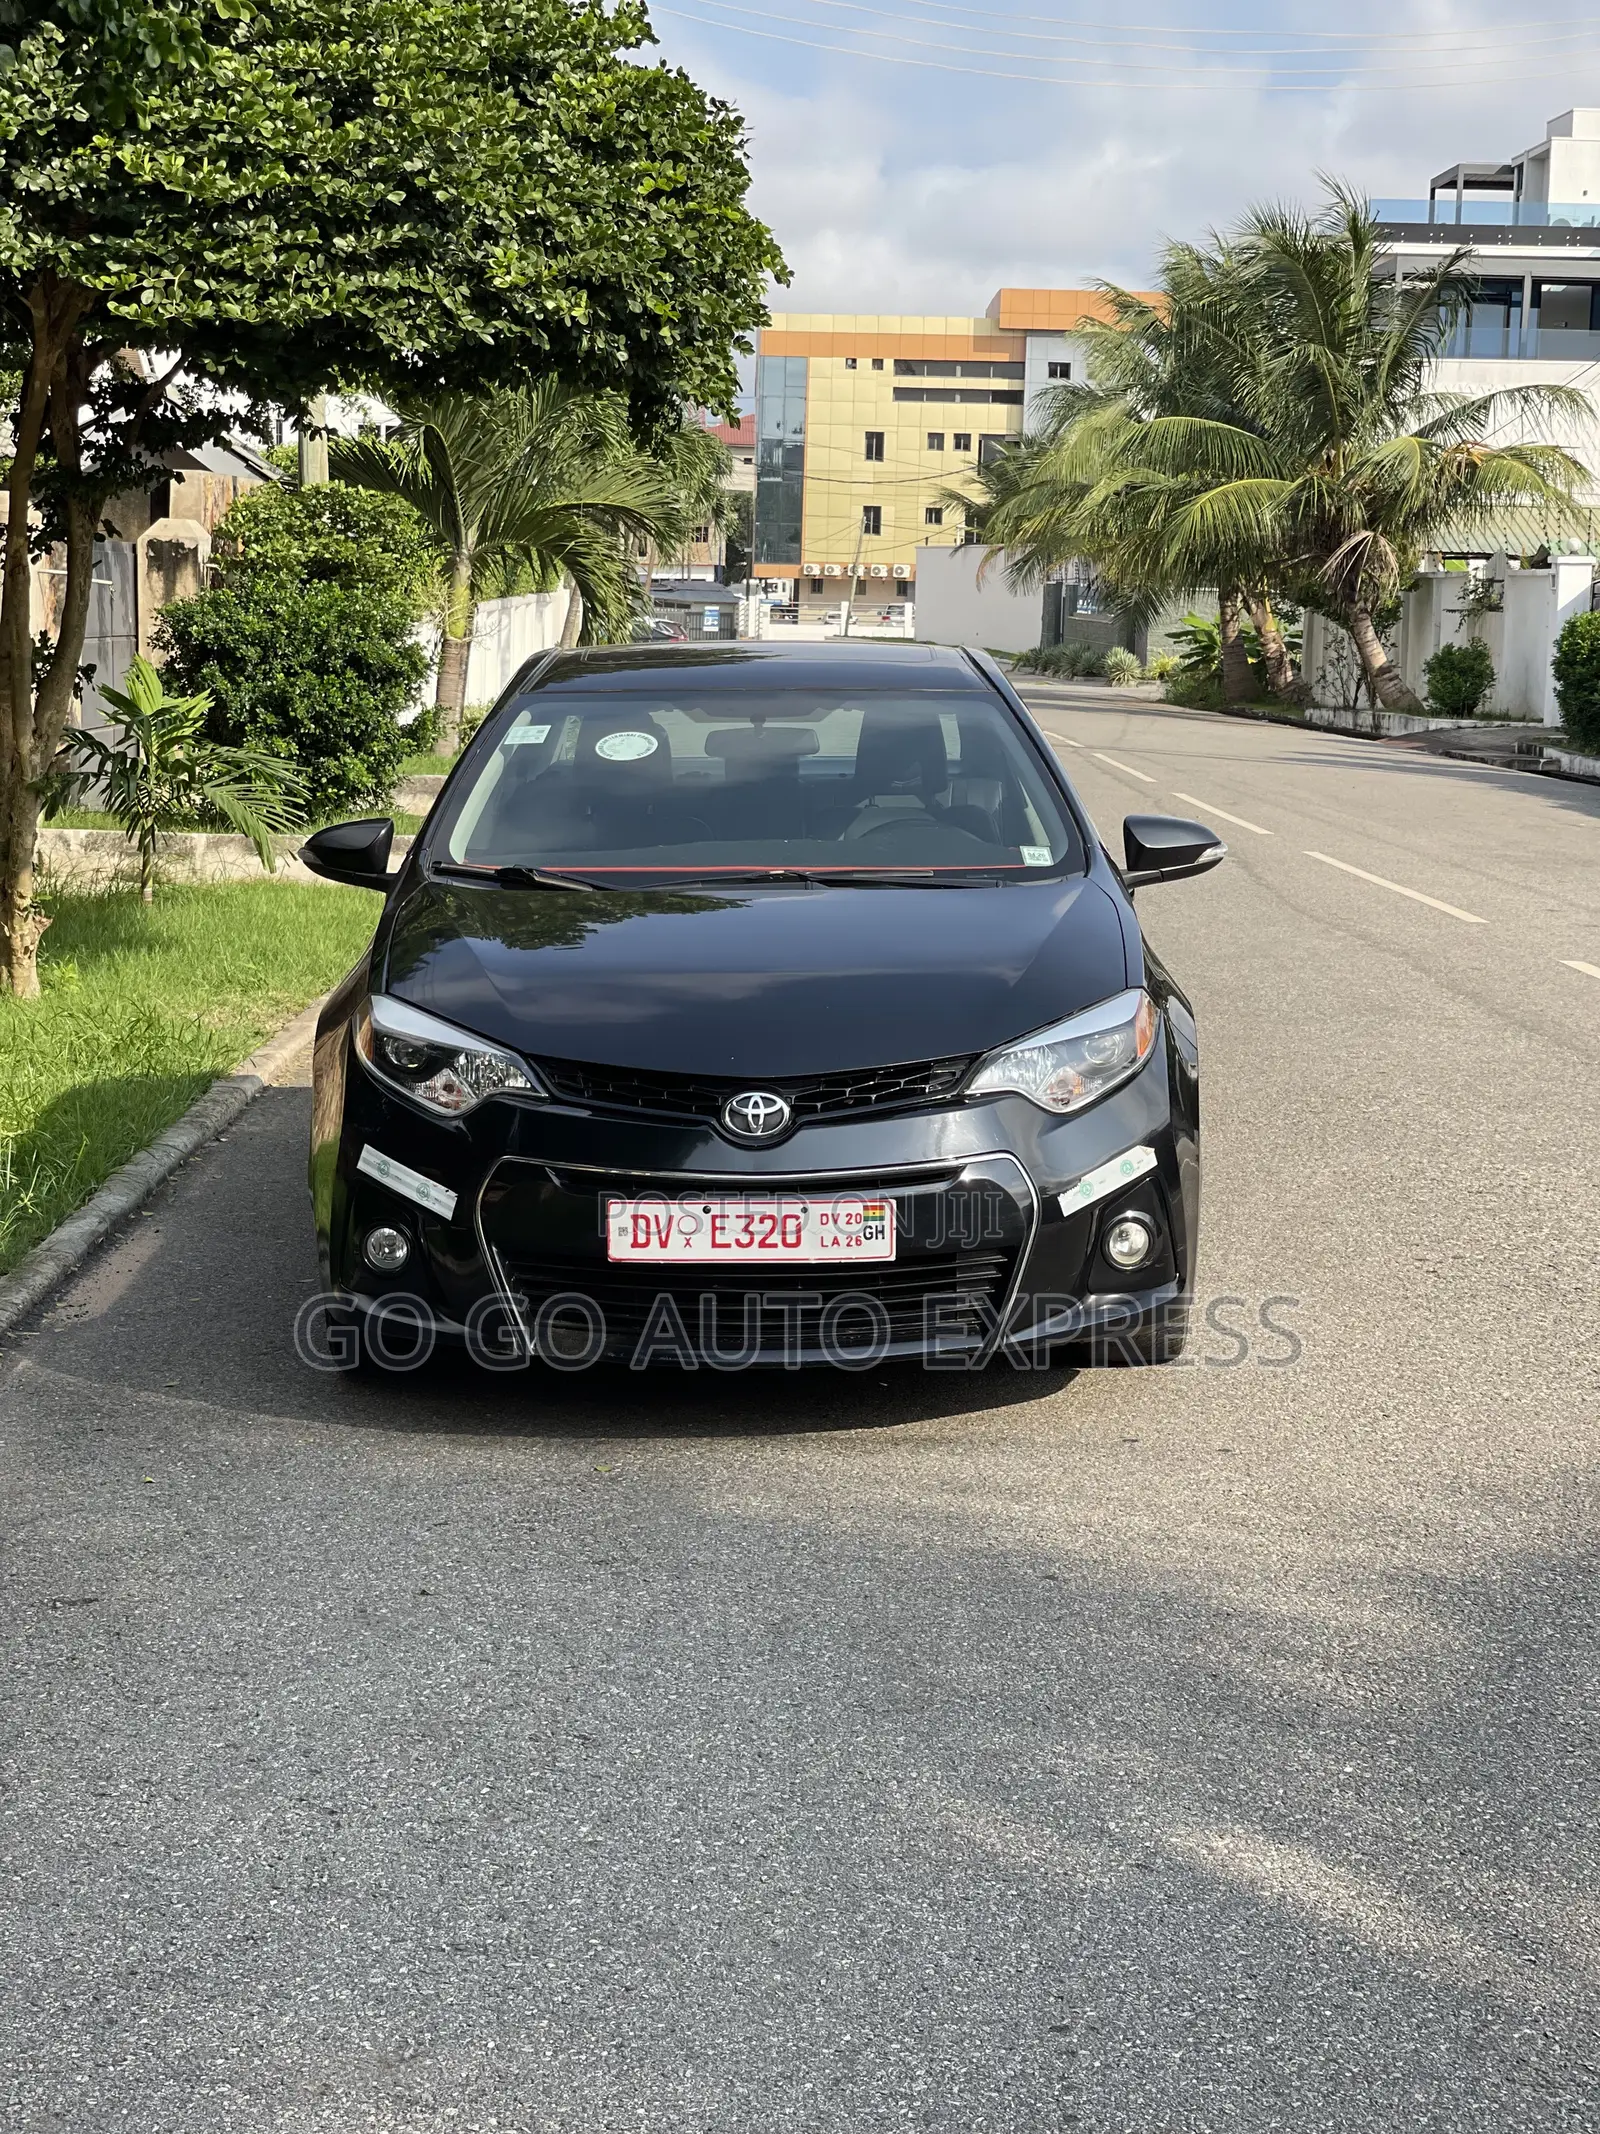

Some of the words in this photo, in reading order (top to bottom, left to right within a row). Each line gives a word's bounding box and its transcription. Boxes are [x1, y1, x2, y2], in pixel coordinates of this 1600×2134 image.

[820, 1213, 840, 1225] DV
[845, 1212, 862, 1225] 20
[630, 1214, 674, 1249] DV
[711, 1213, 802, 1249] E320
[862, 1225, 885, 1240] GH
[820, 1236, 841, 1247] LA
[845, 1235, 863, 1247] 26
